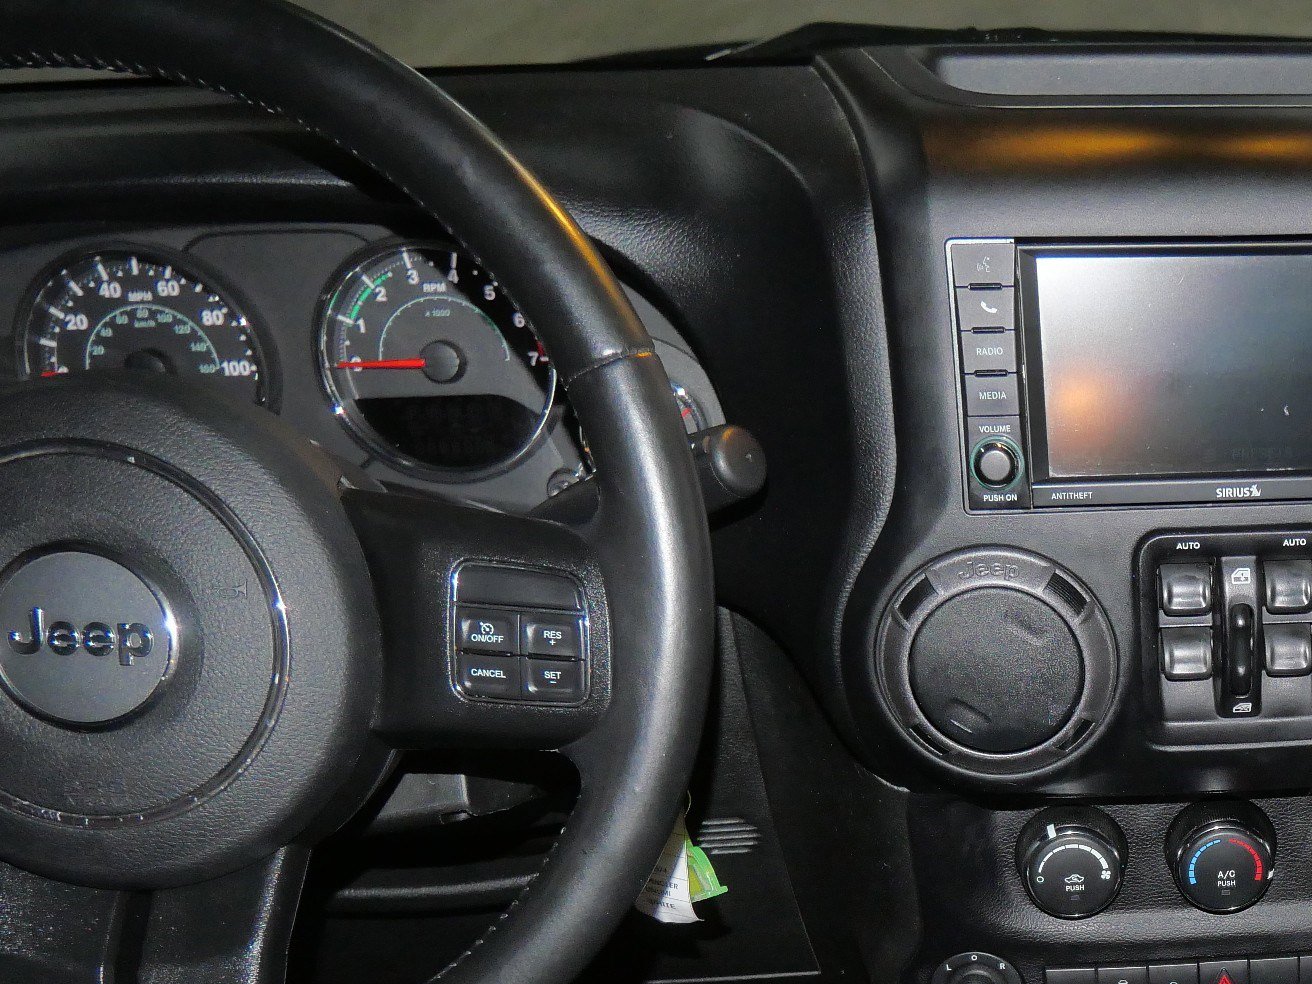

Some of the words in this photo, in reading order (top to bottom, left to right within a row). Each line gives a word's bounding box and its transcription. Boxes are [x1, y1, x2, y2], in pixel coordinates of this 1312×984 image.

[406, 269, 419, 285] 3
[448, 268, 459, 284] 4
[99, 281, 122, 298] 40
[157, 279, 180, 297] 60
[423, 282, 447, 293] RPM
[483, 285, 496, 301] 5
[374, 286, 387, 302] 2
[64, 313, 88, 330] 20
[201, 309, 224, 326] 80
[512, 312, 525, 328] 6
[356, 317, 366, 333] 1
[976, 347, 1004, 355] RADIO
[528, 351, 539, 366] 7
[221, 360, 250, 376] 100
[979, 391, 1007, 400] MEDIA
[979, 425, 1011, 433] VOLUME
[983, 494, 1004, 502] PUSH
[1051, 492, 1092, 500] ANTITHEFT
[1216, 487, 1250, 498] SIRIUS
[1176, 541, 1200, 550] AUTO
[1282, 538, 1307, 547] AUTO
[957, 561, 1020, 581] Jeep
[7, 606, 154, 667] Jeep
[471, 633, 504, 644] ON/OFF
[543, 630, 562, 640] RES
[471, 668, 506, 679] CANCEL
[544, 671, 561, 680] SET
[1217, 869, 1236, 880] A/C
[1065, 884, 1085, 892] PUSH
[1217, 880, 1236, 888] PUSH
[946, 963, 952, 971] L
[999, 962, 1006, 970] R
